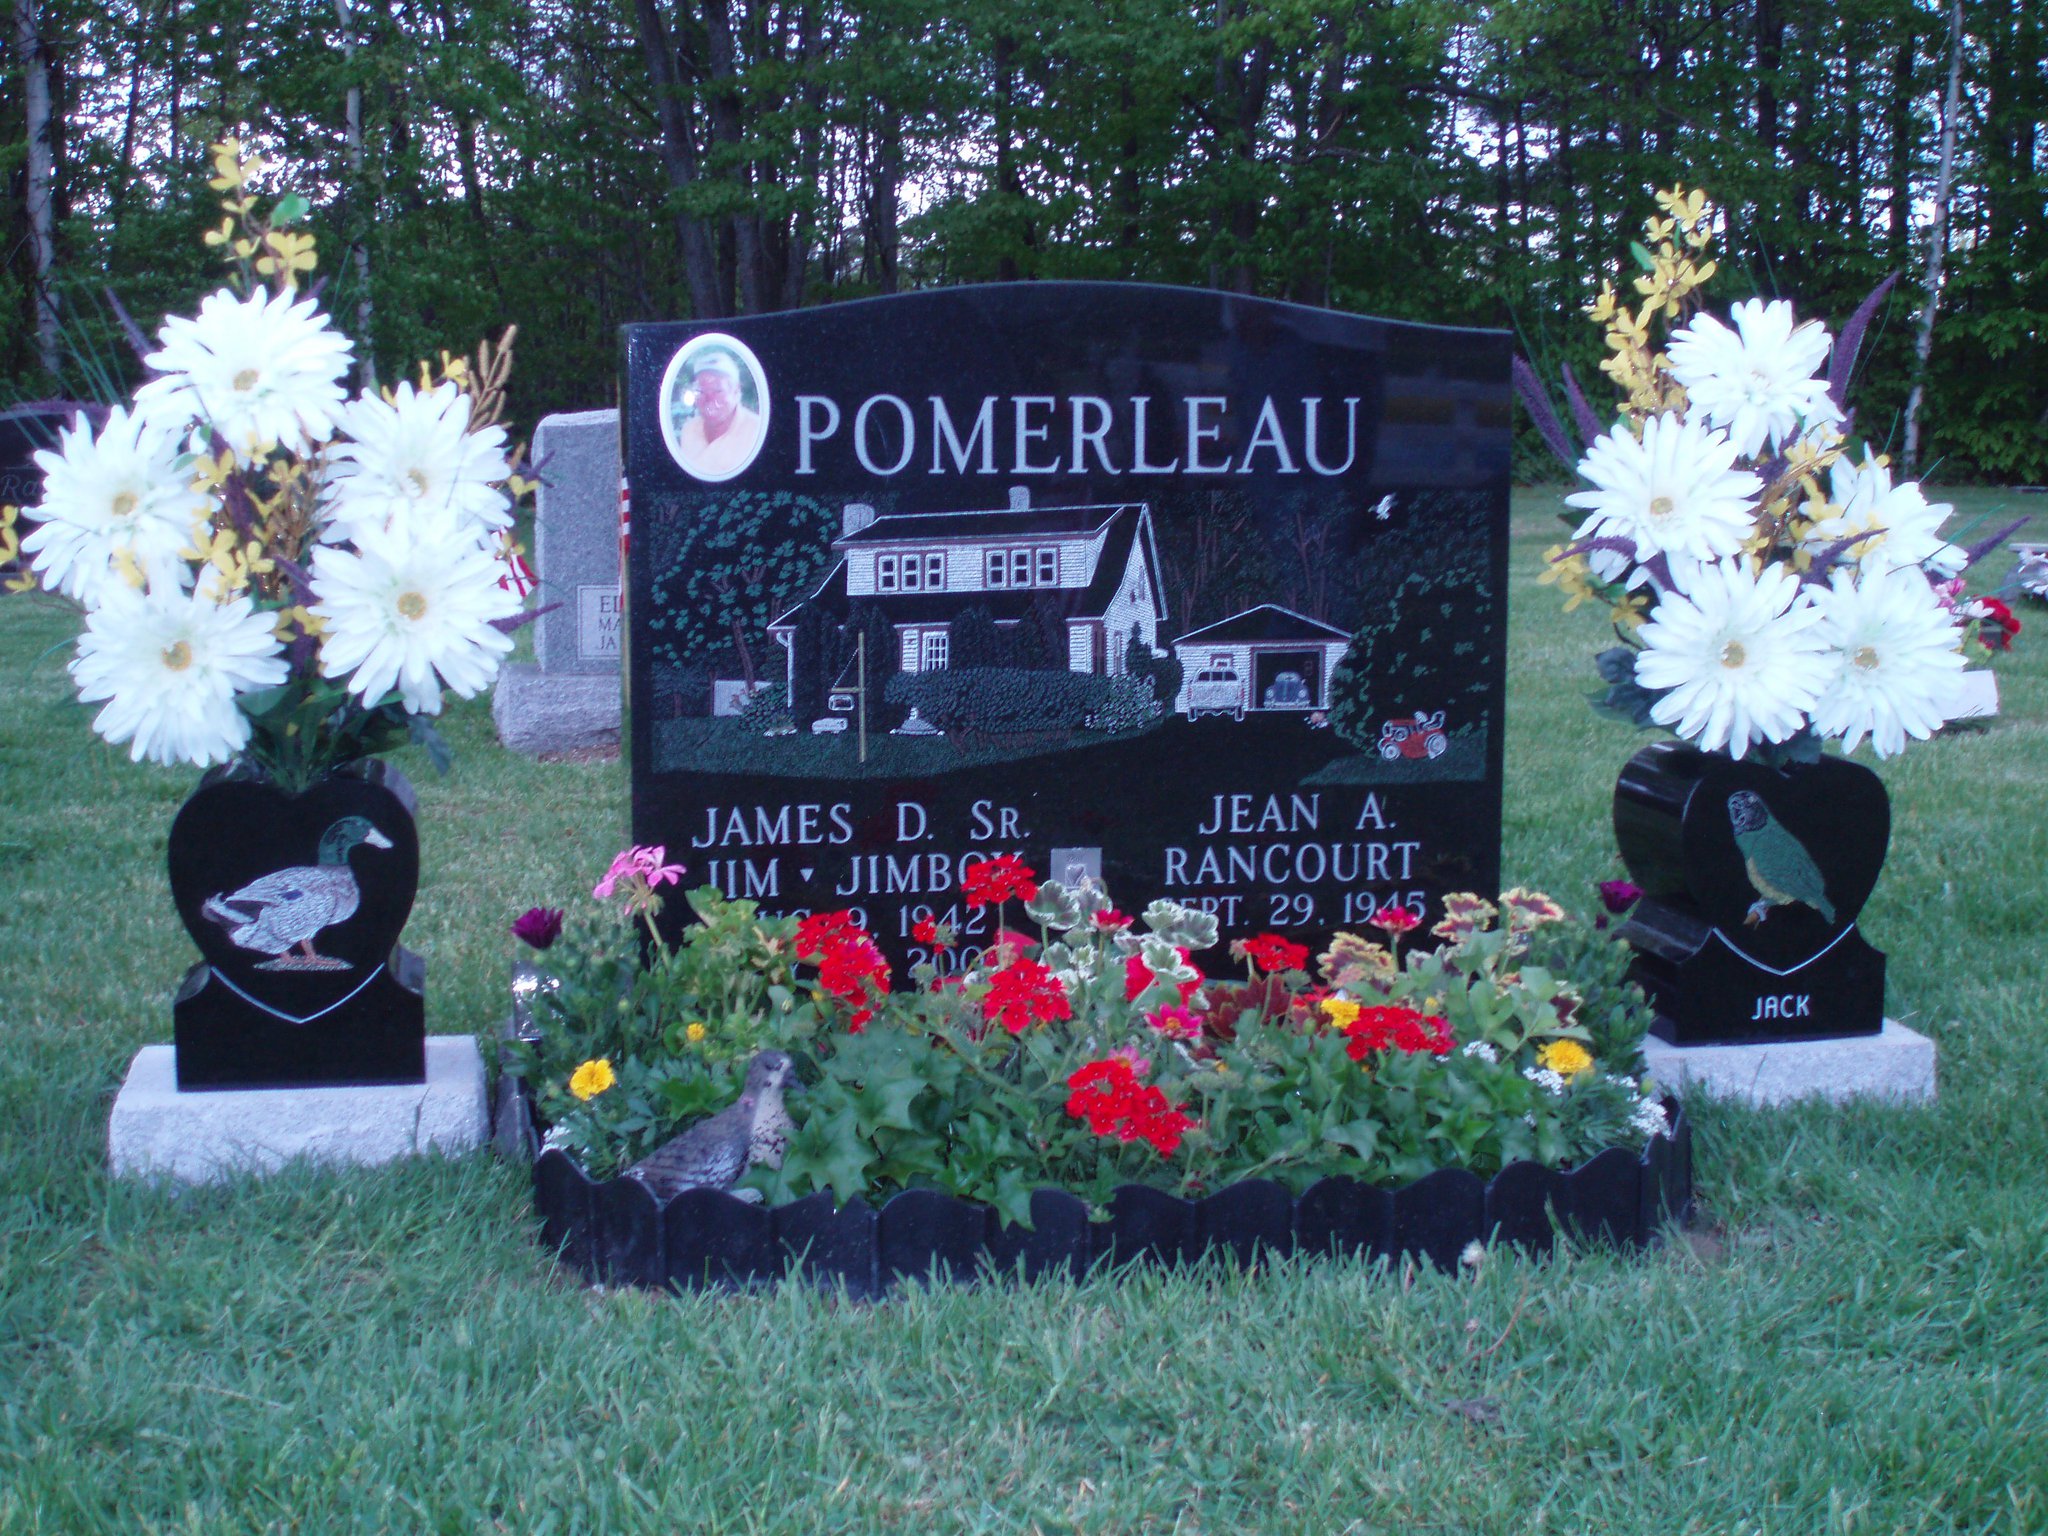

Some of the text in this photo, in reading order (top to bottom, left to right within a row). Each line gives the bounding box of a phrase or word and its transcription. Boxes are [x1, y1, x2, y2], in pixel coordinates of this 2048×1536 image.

[794, 393, 1361, 476] POMERLEAU
[691, 803, 854, 849] JAMES
[896, 801, 934, 842] D.
[1198, 791, 1397, 835] JEAN A.
[836, 850, 1024, 896] JIMBO
[1164, 841, 1421, 886] RANCOURT
[899, 903, 987, 937] 1942
[1160, 895, 1250, 927] PT.
[1343, 890, 1427, 926] 1945
[1751, 994, 1811, 1021] JACK
